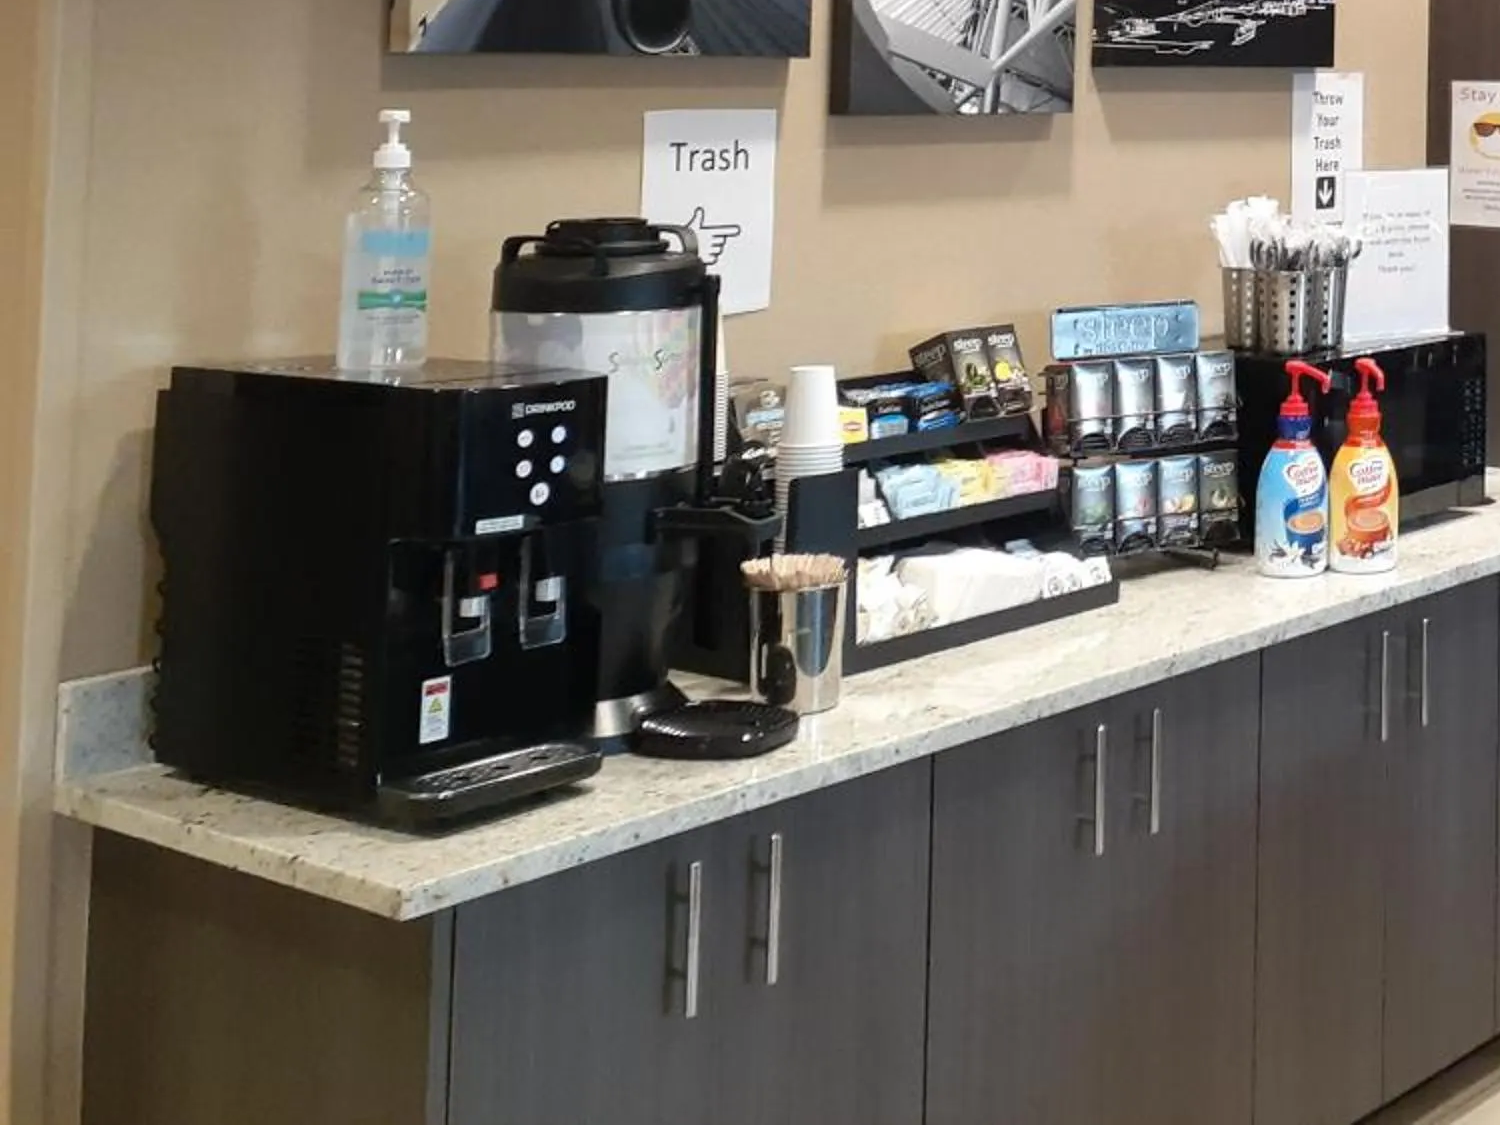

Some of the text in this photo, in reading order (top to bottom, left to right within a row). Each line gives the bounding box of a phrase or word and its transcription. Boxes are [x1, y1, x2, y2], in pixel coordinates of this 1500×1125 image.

[1312, 91, 1344, 105] Throw
[1460, 87, 1497, 104] Stay
[1316, 114, 1339, 127] Your
[1313, 136, 1341, 150] Trash
[669, 139, 749, 172] Trash
[1315, 157, 1339, 172] Here
[1080, 311, 1169, 350] steep
[953, 337, 983, 352] steep
[1202, 461, 1235, 478] steep
